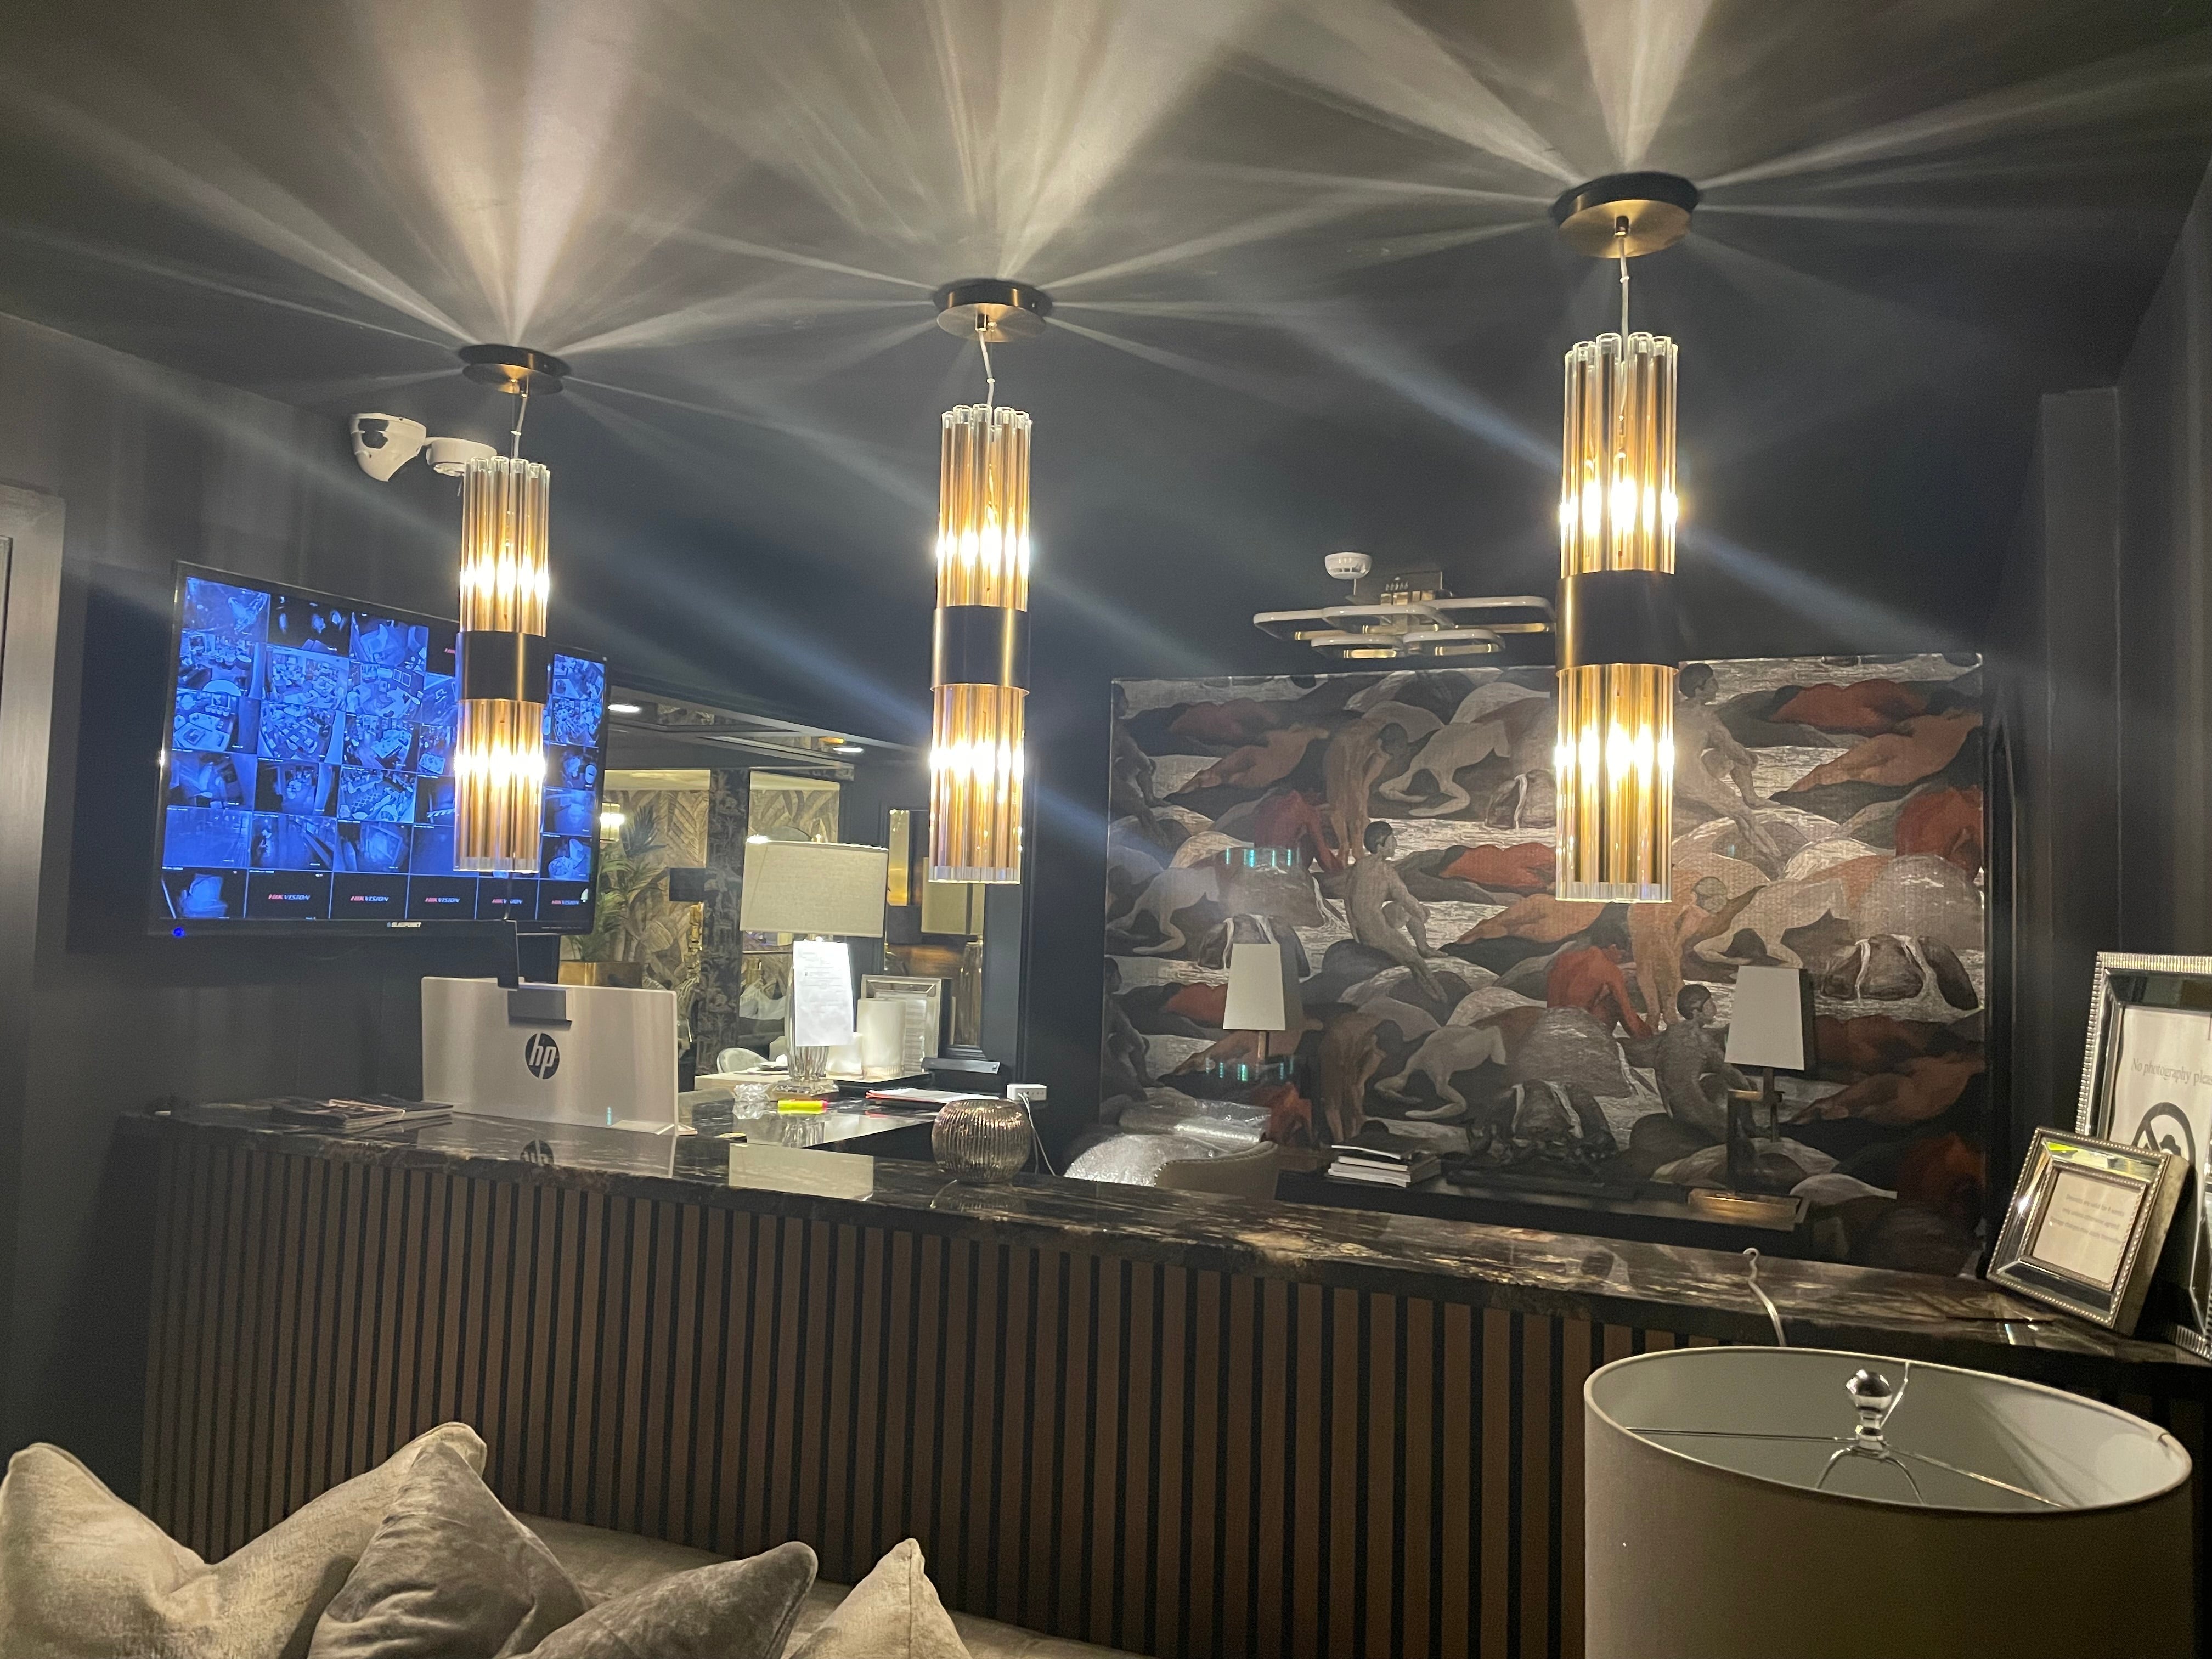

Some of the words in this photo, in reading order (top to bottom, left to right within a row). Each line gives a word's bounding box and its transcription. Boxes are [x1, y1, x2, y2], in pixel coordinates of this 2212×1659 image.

[528, 1032, 557, 1080] hp
[2131, 1058, 2142, 1071] No
[2143, 1060, 2192, 1084] photography
[2193, 1069, 2212, 1086] pleas
